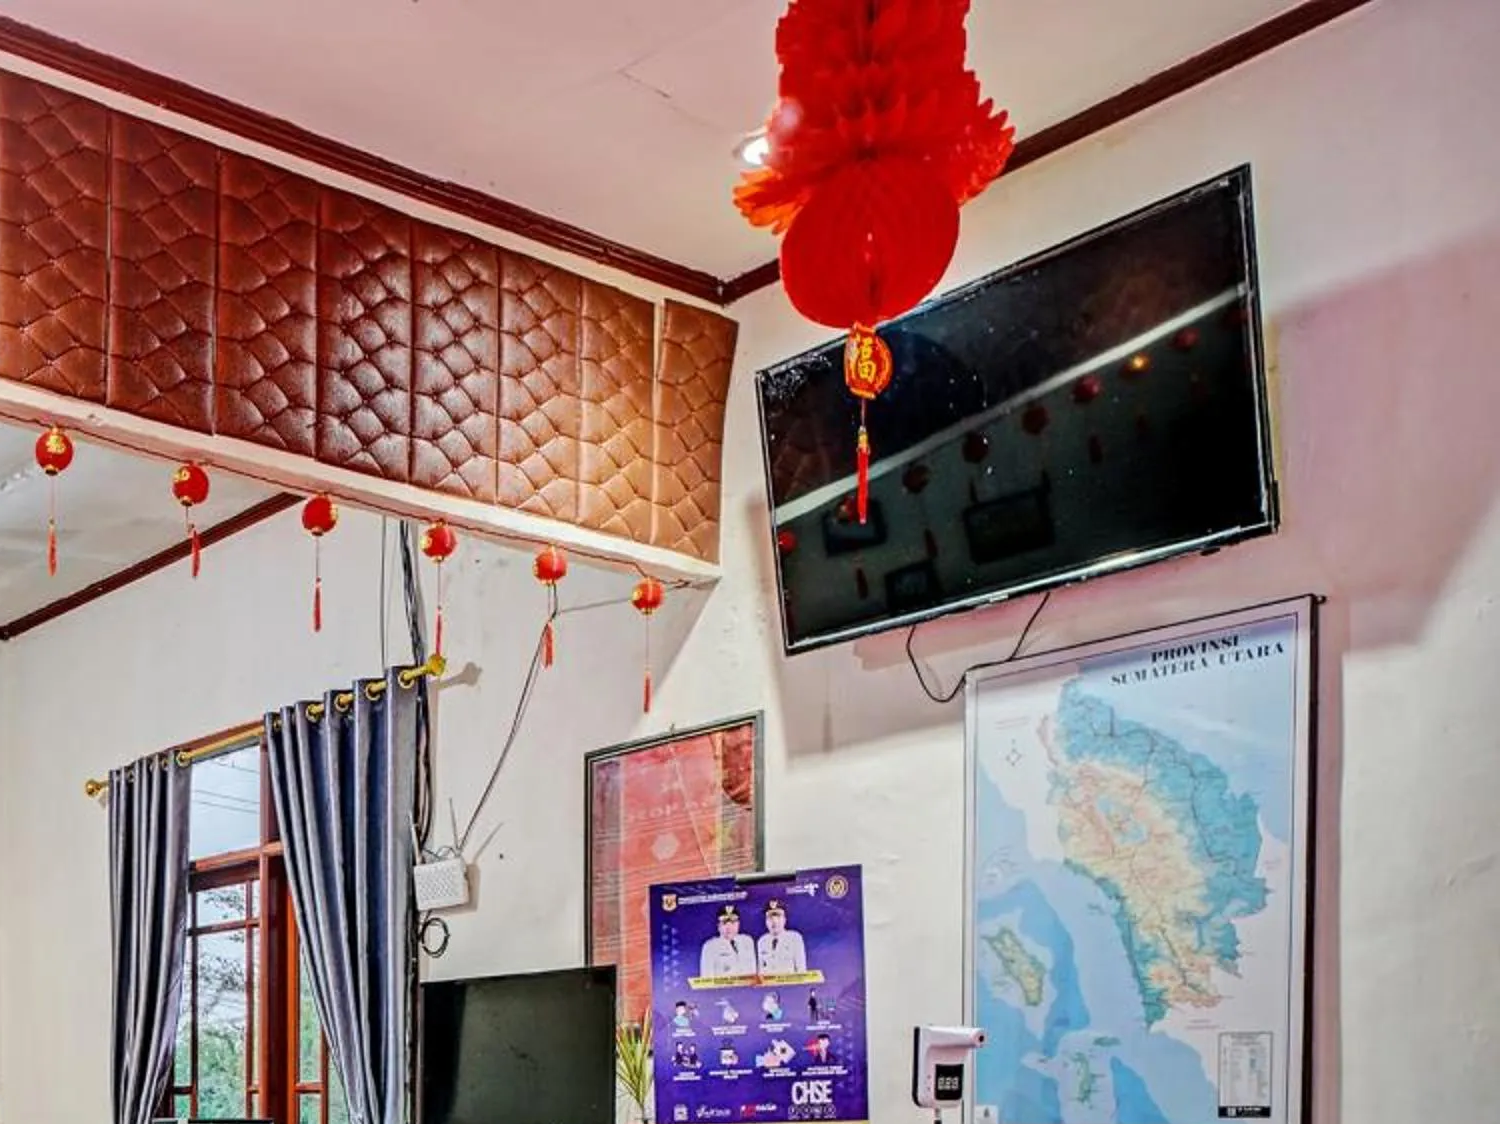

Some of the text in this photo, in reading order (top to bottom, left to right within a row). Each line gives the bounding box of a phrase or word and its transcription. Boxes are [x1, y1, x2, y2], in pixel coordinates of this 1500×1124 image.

[1151, 635, 1239, 663] PROVINSI
[1110, 641, 1285, 686] SUMATERA UTARA
[791, 1080, 833, 1105] CHSE
